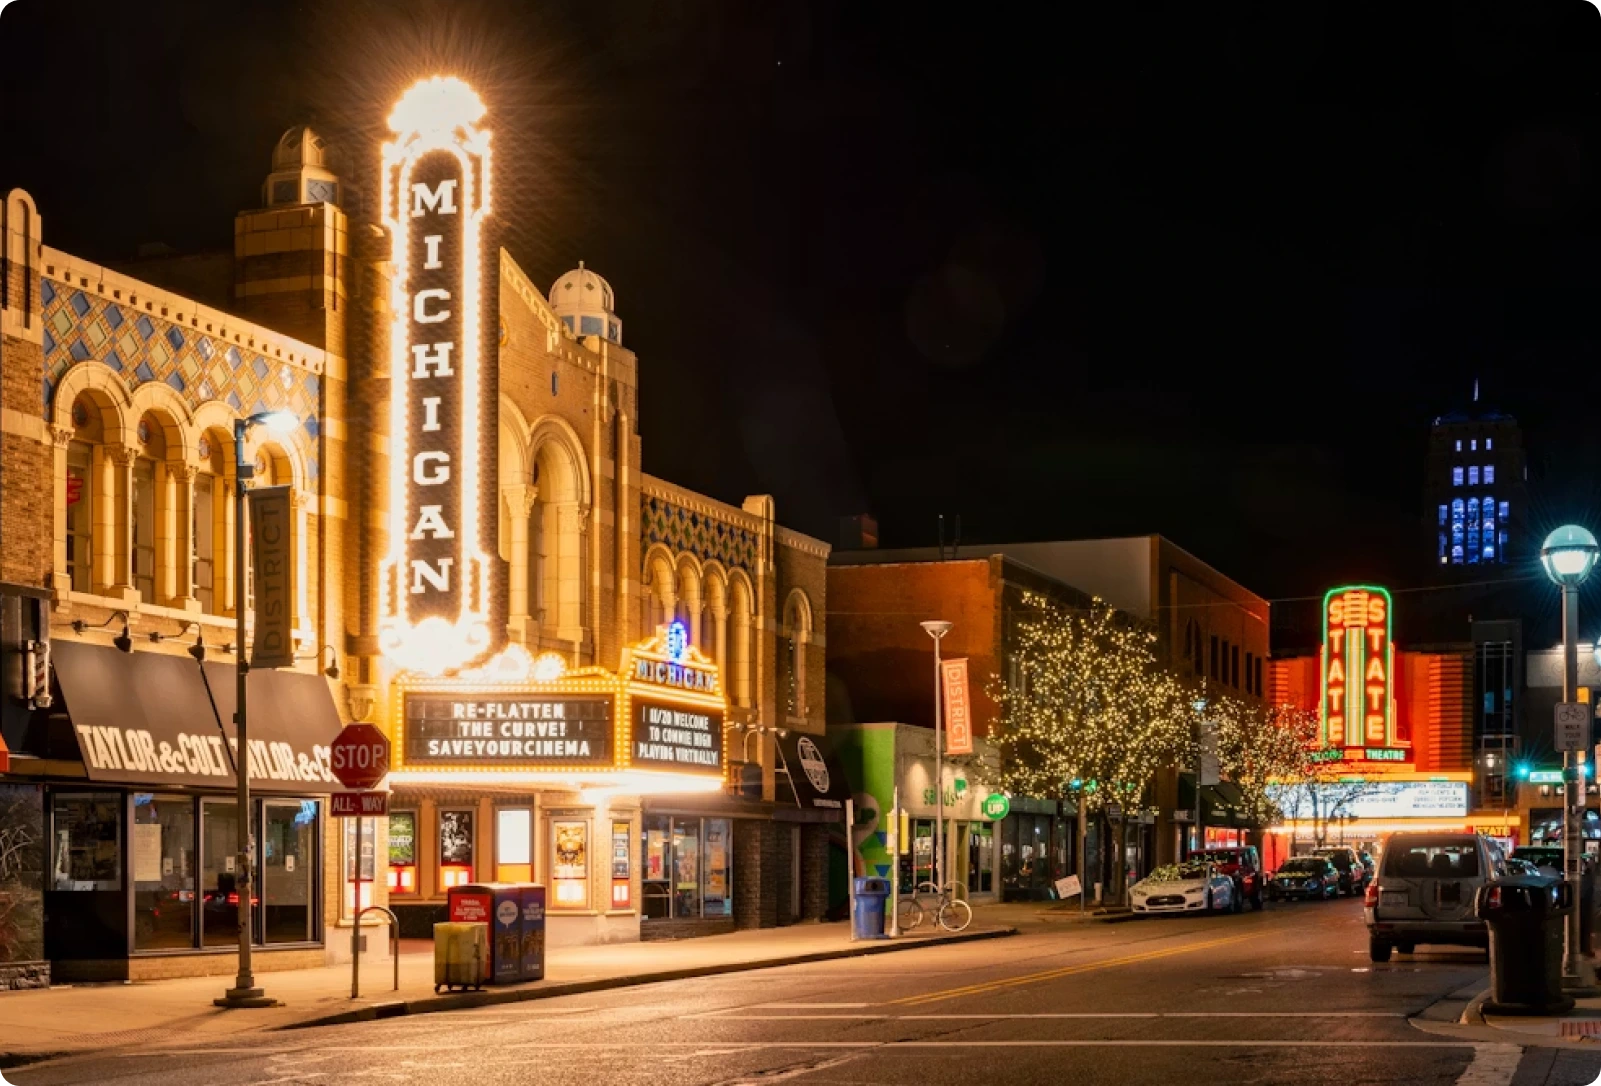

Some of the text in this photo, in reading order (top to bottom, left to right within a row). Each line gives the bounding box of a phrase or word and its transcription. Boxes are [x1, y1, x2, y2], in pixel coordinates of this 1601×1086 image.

[411, 179, 457, 594] MICHIGAN
[261, 504, 283, 651] DISTRICT
[636, 659, 714, 692] MICHIGAN
[1328, 599, 1344, 742] STATE
[1366, 598, 1386, 740] STATE
[453, 703, 565, 719] RE-FLATTEN
[947, 669, 966, 746] DISTRICT
[460, 721, 566, 737] THE CURVE!
[674, 710, 709, 730] WELCOME
[650, 726, 660, 742] TO
[333, 744, 385, 769] STOP
[428, 740, 591, 757] SAVEYOURCINEMA
[639, 742, 717, 766] PLAYING VIRTUALLY
[1366, 749, 1406, 761] THEATRE
[361, 796, 383, 812] WAY
[923, 786, 955, 807] sads
[987, 803, 1005, 815] UP
[1477, 826, 1511, 837] STATE
